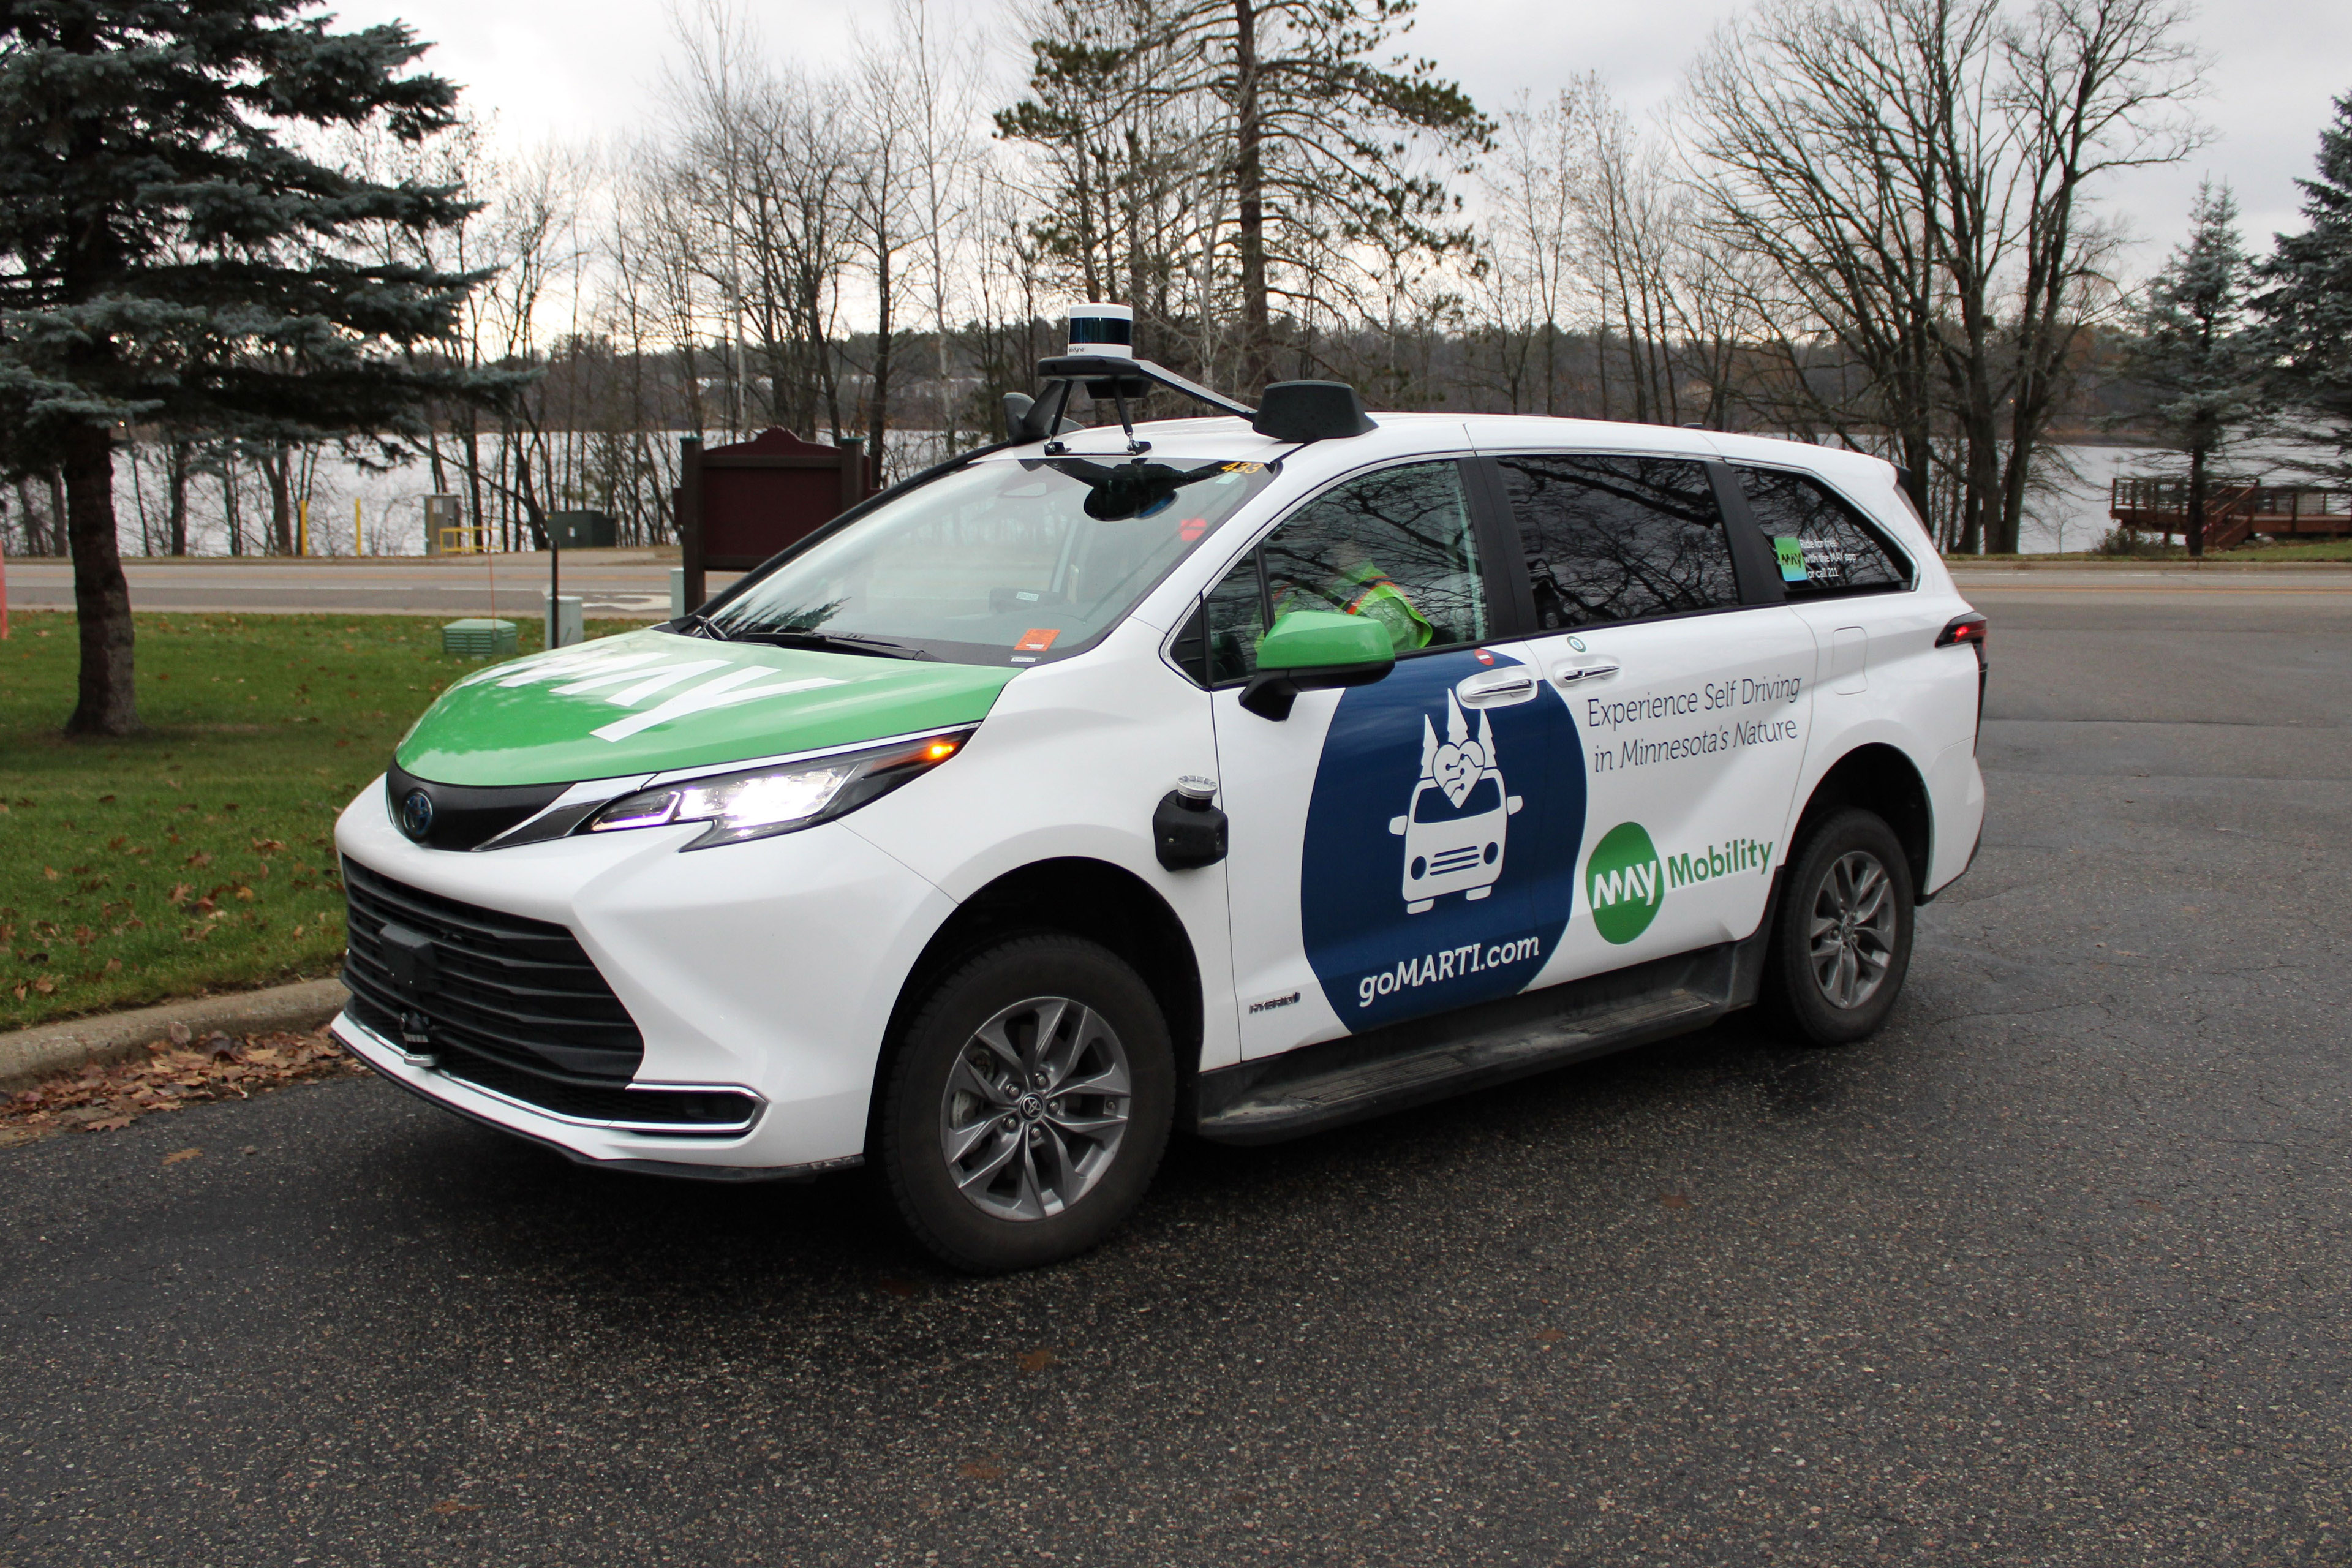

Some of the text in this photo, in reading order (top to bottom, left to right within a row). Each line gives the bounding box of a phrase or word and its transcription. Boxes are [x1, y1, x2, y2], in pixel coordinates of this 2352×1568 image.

[1221, 462, 1264, 474] 433
[1799, 538, 1838, 548] Ride for free
[1781, 552, 1801, 568] MAY
[1803, 552, 1856, 563] with the MAY app
[1815, 568, 1827, 578] call
[1828, 568, 1839, 577] 211
[1588, 674, 1801, 731] Experience Self Driving
[1595, 720, 1798, 773] in Minnesota's Nature
[1593, 839, 1773, 910] MAY Mobility
[1359, 936, 1539, 1008] goMARTI.com
